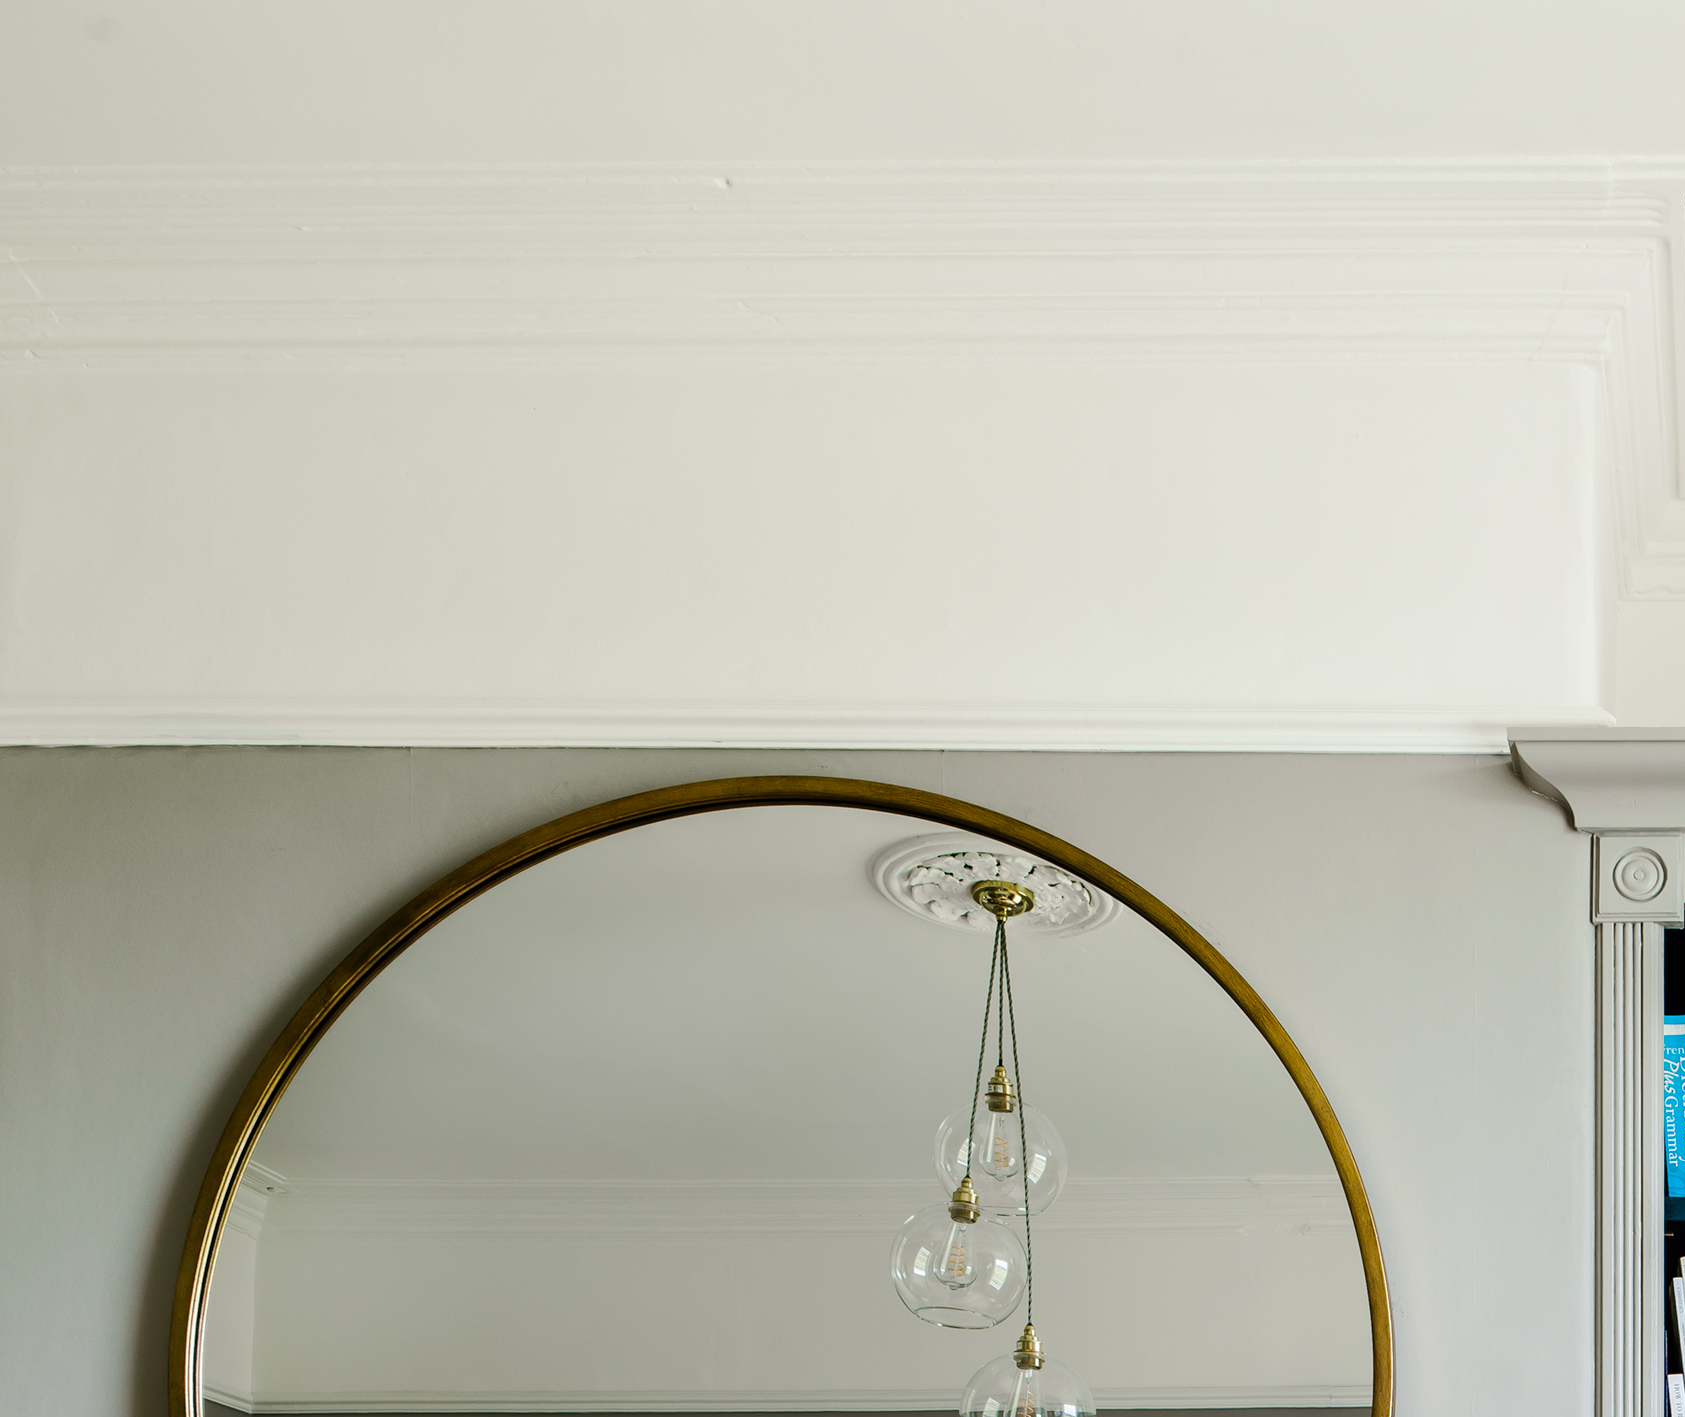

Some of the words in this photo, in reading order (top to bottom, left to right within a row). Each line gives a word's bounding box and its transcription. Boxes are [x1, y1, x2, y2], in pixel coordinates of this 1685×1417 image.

[1664, 1059, 1679, 1093] Plus
[1665, 1096, 1679, 1167] Grammar
[1673, 1384, 1681, 1400] HOW
[1675, 1402, 1682, 1411] TO
